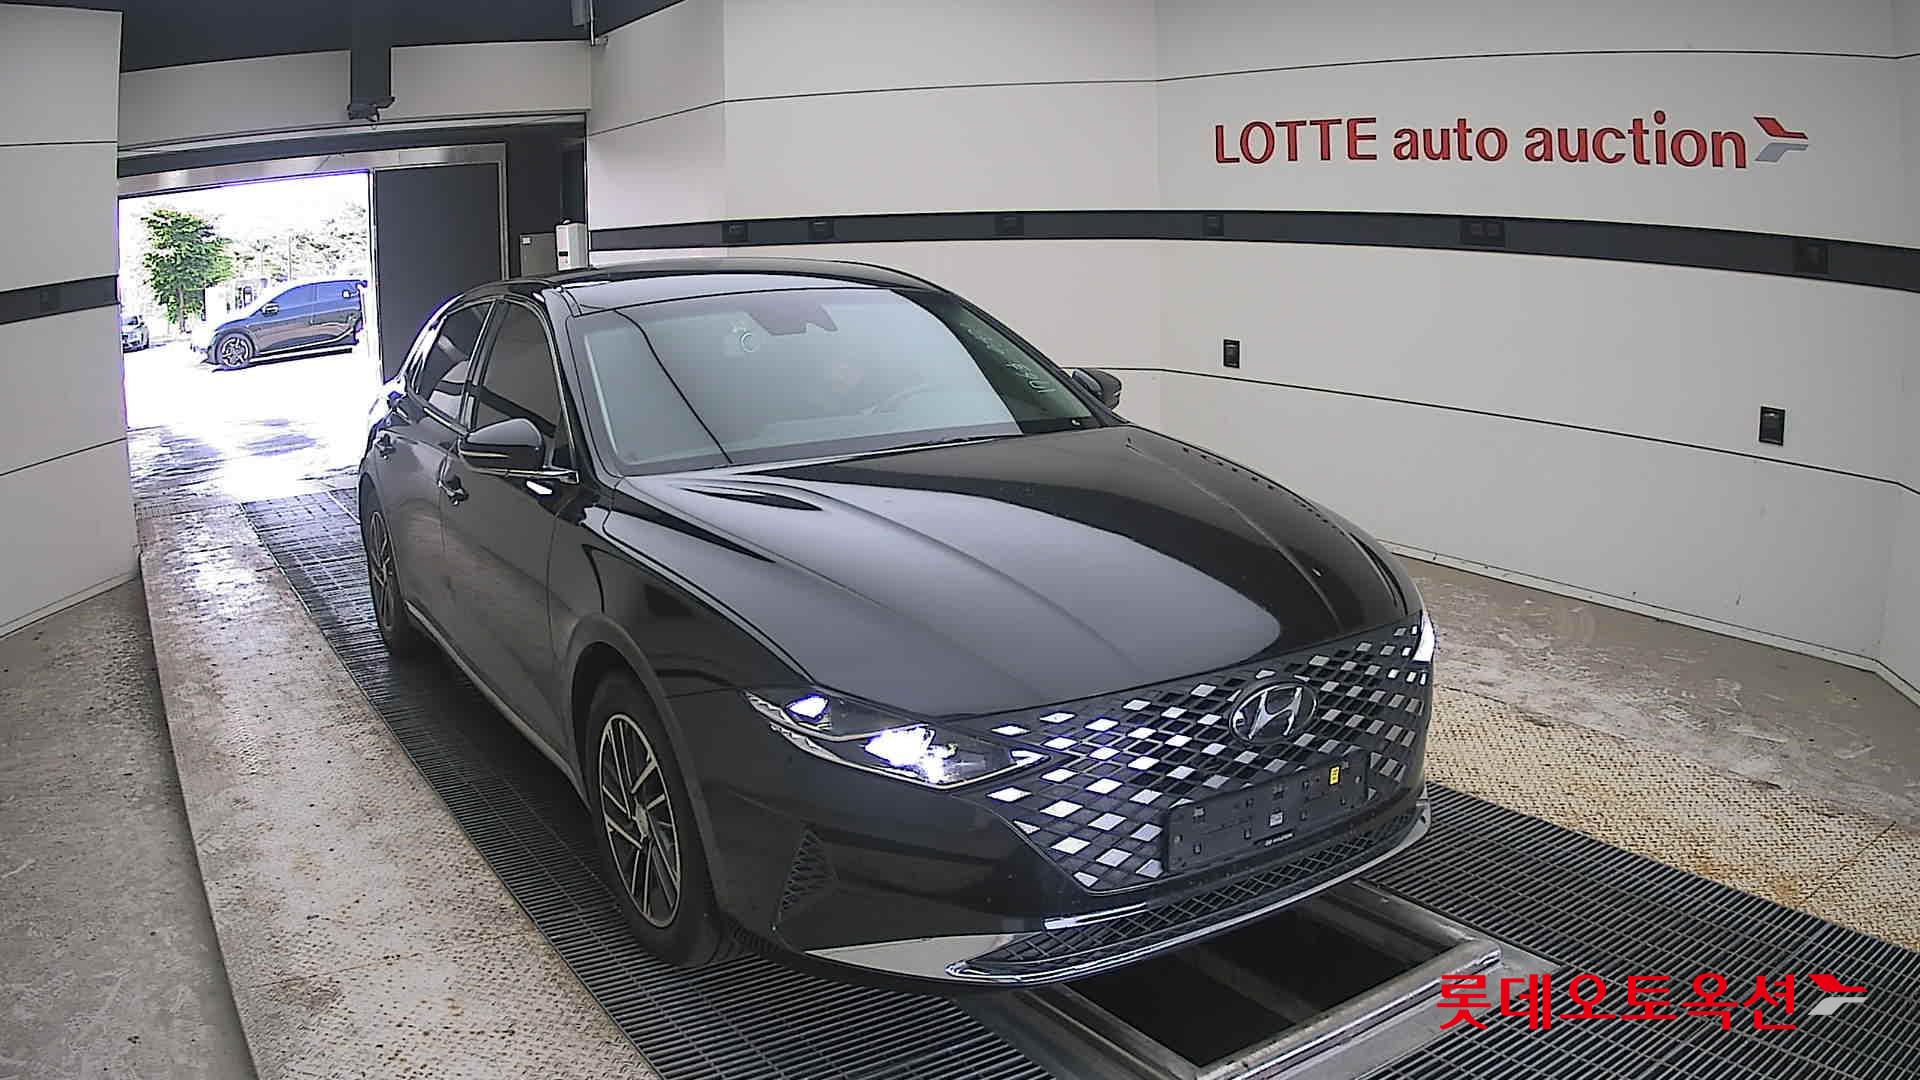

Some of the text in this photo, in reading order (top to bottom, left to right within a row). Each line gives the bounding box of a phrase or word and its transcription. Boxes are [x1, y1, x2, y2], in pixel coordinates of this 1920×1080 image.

[1215, 110, 1747, 169] LOTTE auto auction
